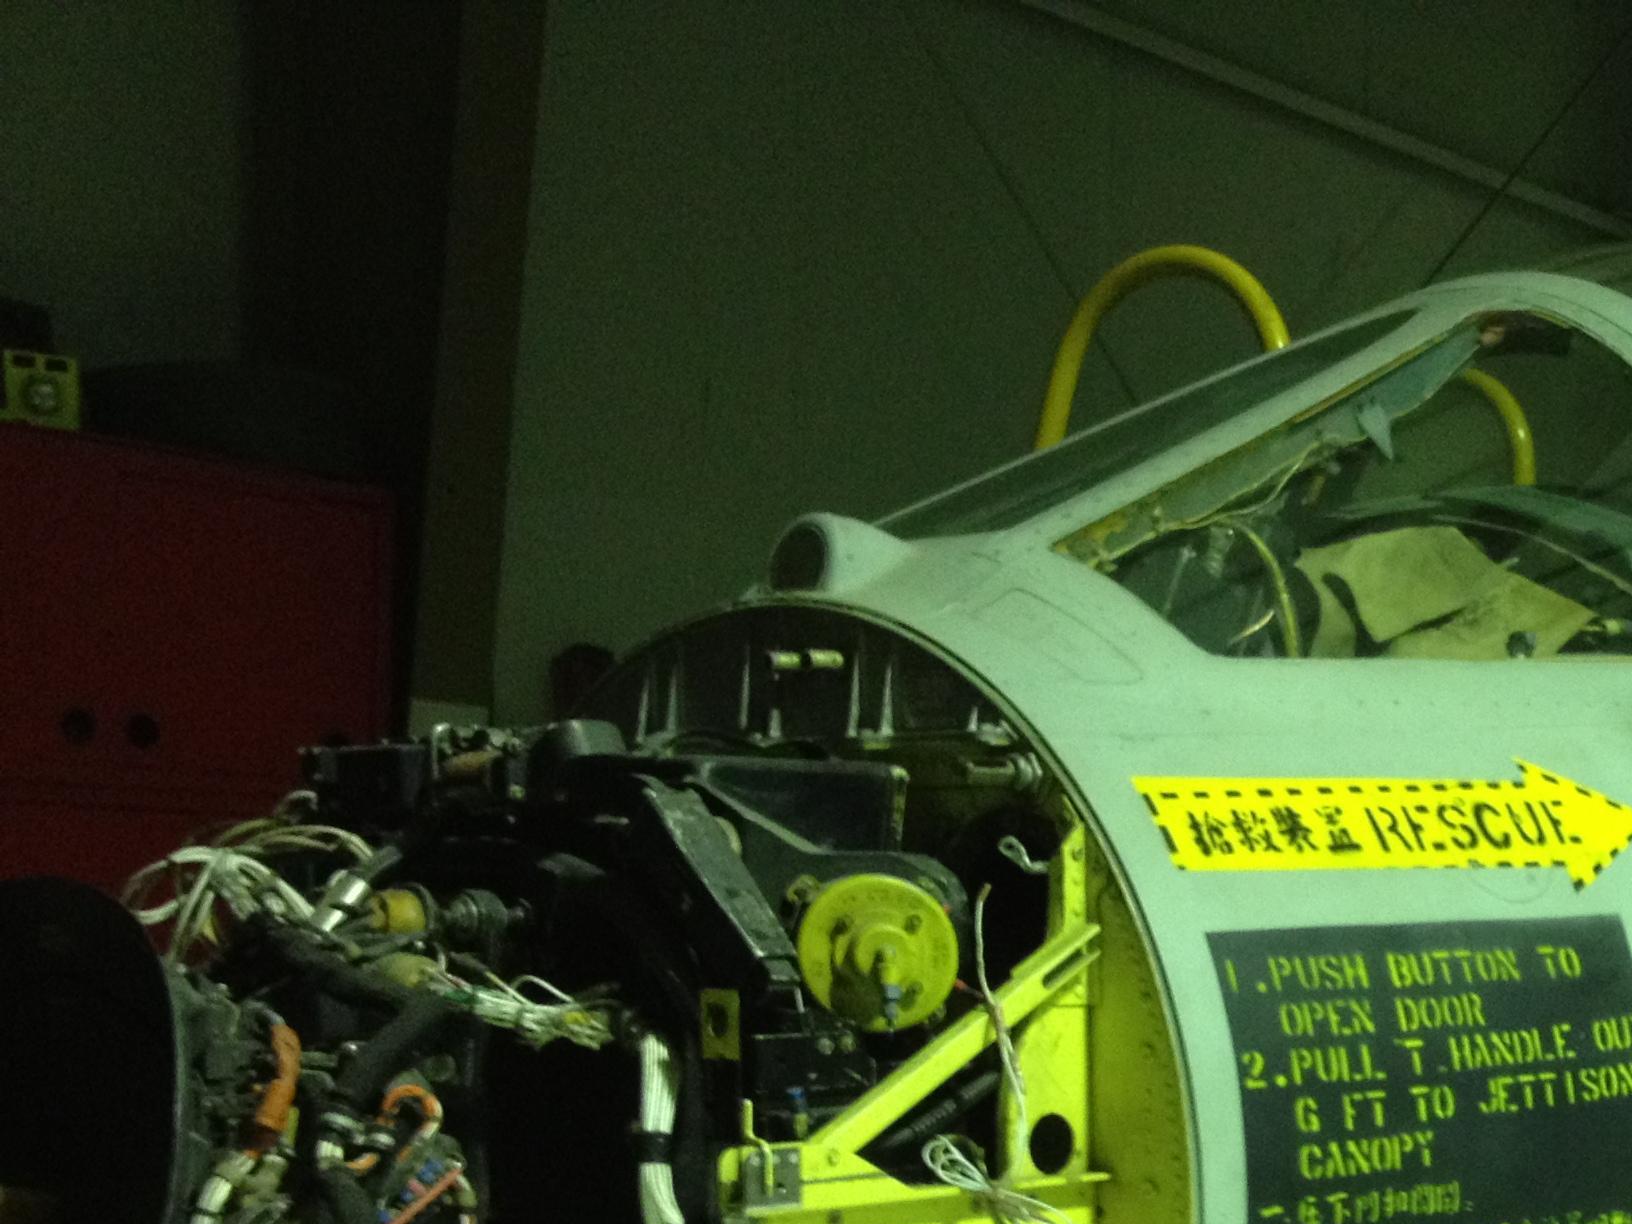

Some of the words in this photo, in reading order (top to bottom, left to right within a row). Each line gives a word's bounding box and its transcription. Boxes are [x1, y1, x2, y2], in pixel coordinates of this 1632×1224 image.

[1364, 800, 1582, 853] RESCUE
[1386, 949, 1520, 987] BUTTON
[1537, 946, 1581, 978] TO
[1279, 1001, 1375, 1036] OPEN
[1395, 993, 1485, 1031] DOOR
[1395, 1038, 1424, 1075] T
[1449, 1024, 1576, 1071] HANDLE
[1343, 1091, 1386, 1130] FT
[1409, 1086, 1455, 1121] TO
[1300, 1131, 1434, 1180] CANOPY
